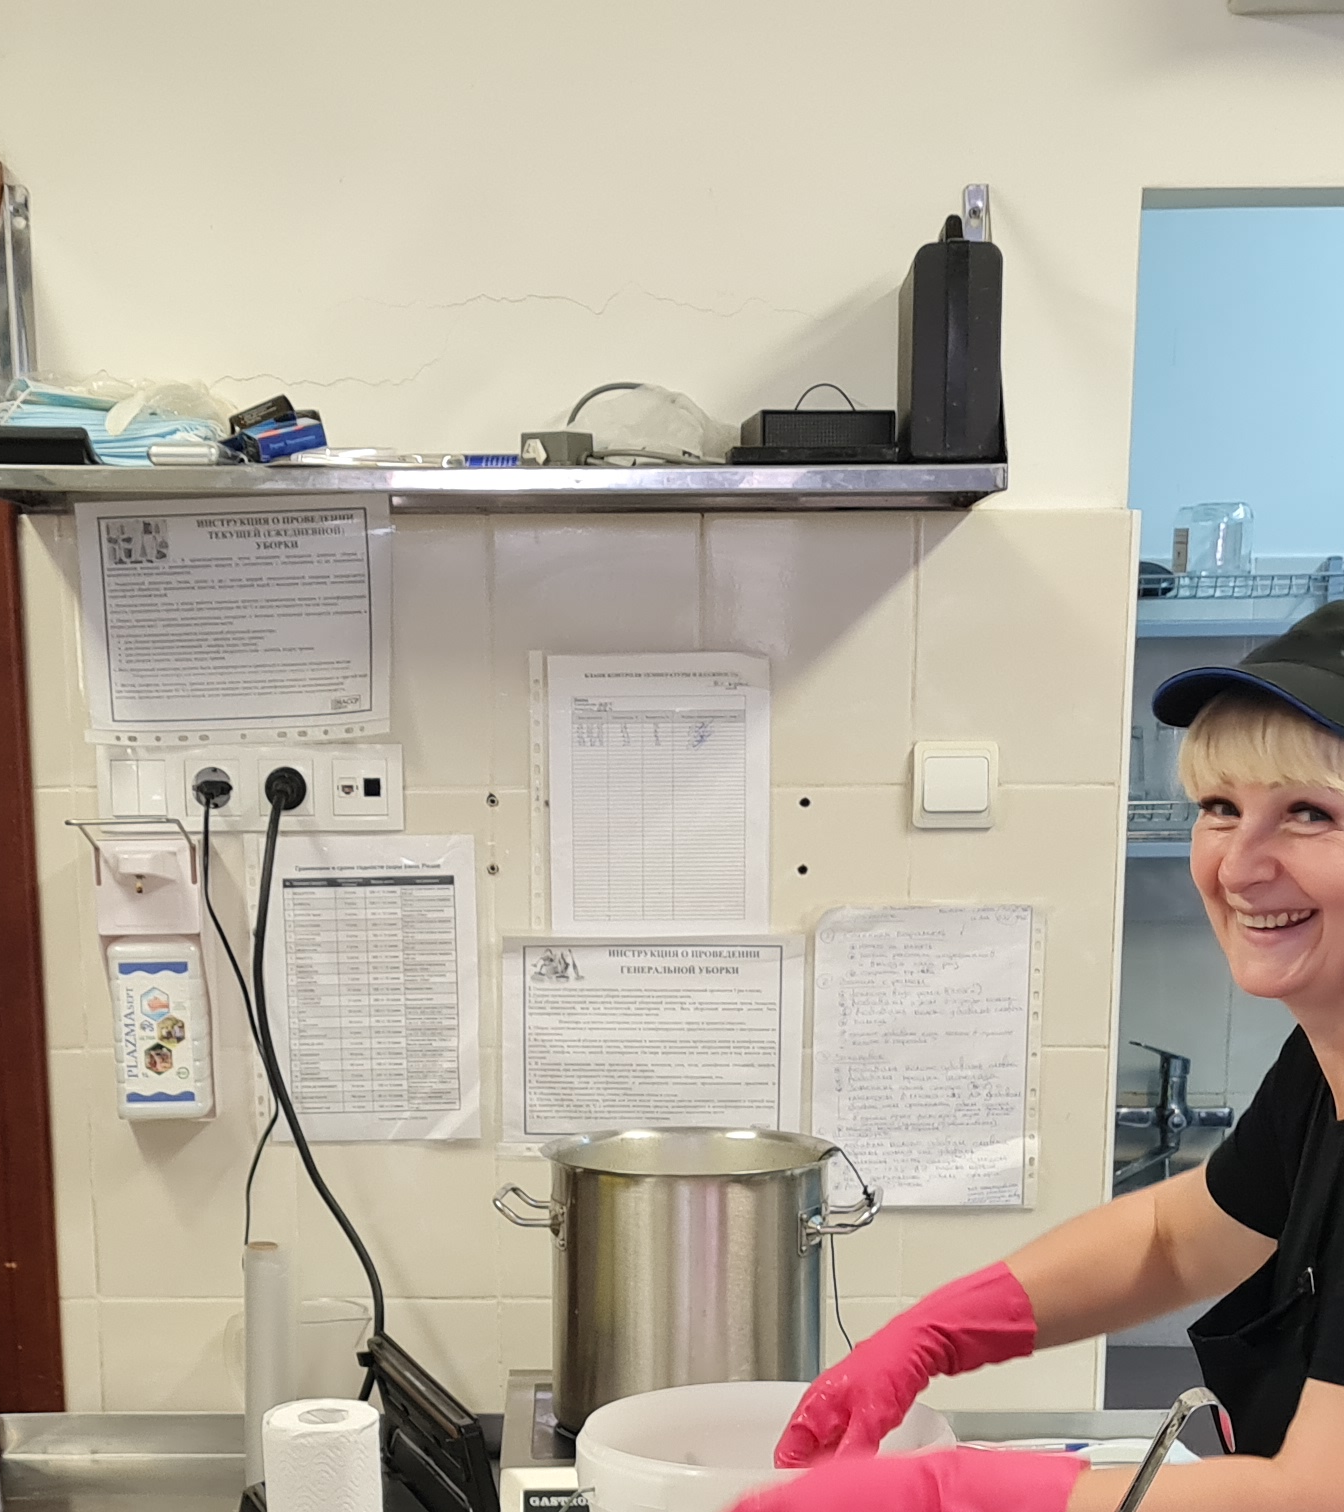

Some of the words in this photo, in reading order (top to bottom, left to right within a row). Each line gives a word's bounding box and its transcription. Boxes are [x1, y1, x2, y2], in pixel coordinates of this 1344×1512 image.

[196, 517, 270, 528] ИНСТРУКЦИЯ
[256, 540, 299, 550] УБОРКИ
[608, 949, 679, 959] ИНСТРУКЦИЯ
[681, 949, 689, 959] О
[691, 949, 761, 960] ПРОВЕДЕНИИ
[620, 965, 696, 975] ГЕНЕРАЛЬНОЙ
[698, 966, 739, 975] УБОРКИ
